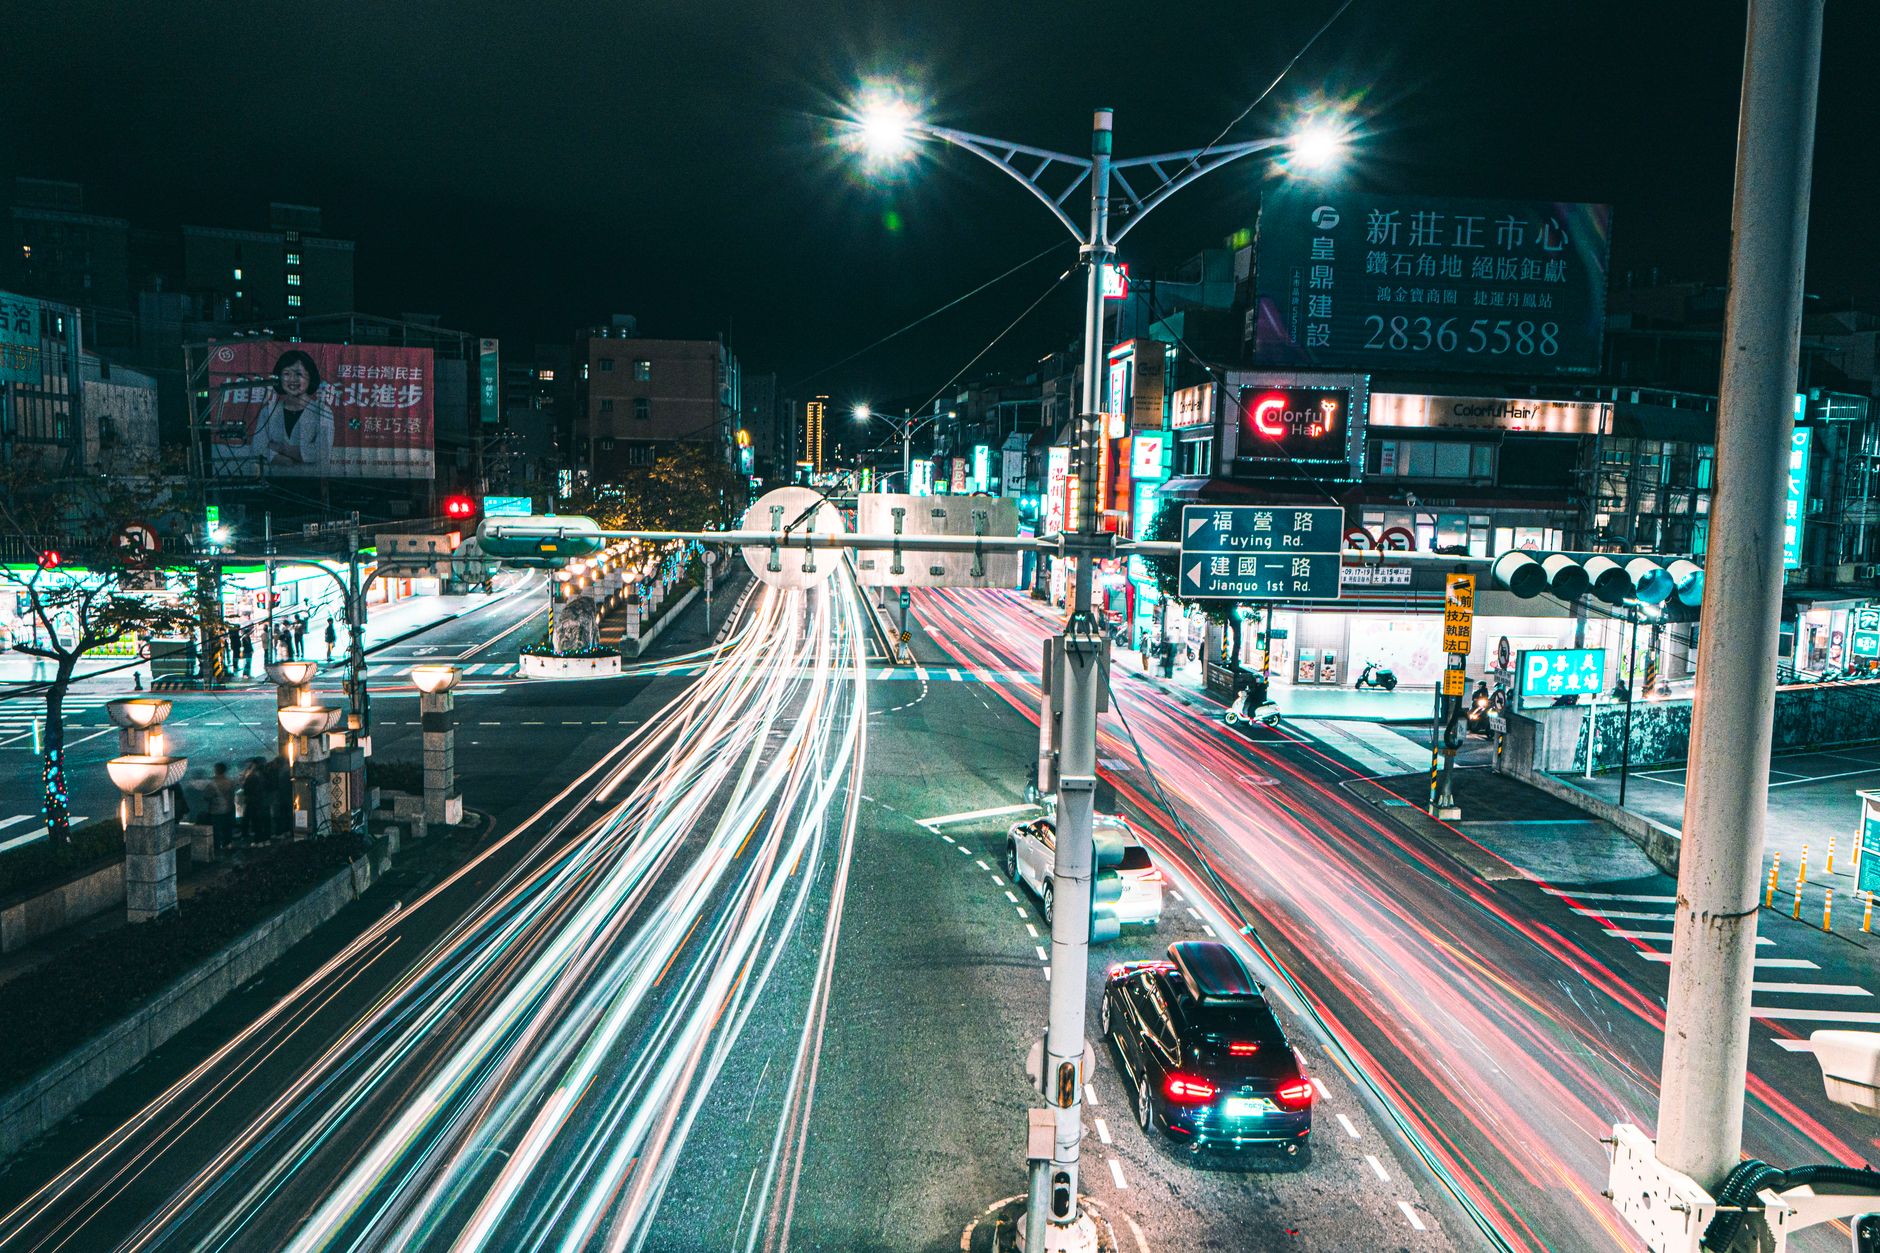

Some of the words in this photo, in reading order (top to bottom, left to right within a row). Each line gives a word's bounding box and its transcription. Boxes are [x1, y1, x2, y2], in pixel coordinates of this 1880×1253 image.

[1366, 208, 1569, 251] 新莊正市心
[1366, 250, 1463, 279] 鑽石角地
[1471, 256, 1568, 283] 絕版鉅獻
[1307, 236, 1335, 348] 皇鼎建設
[1363, 315, 1458, 352] 2836
[1466, 319, 1560, 356] 5588
[1453, 404, 1502, 418] Colorful
[1503, 403, 1531, 419] Hair
[1212, 511, 1313, 532] 福營路
[1219, 534, 1272, 549] Fuying
[1283, 535, 1304, 547] Rd.
[1210, 556, 1311, 577] 建國一路
[1208, 581, 1258, 594] Jianguo
[1266, 581, 1284, 591] 1st
[1293, 581, 1311, 592] Rd.
[1445, 595, 1460, 651] 科技執法
[1457, 594, 1472, 651] 前方路口
[1526, 655, 1548, 691] P
[1547, 673, 1599, 692] 停車場
